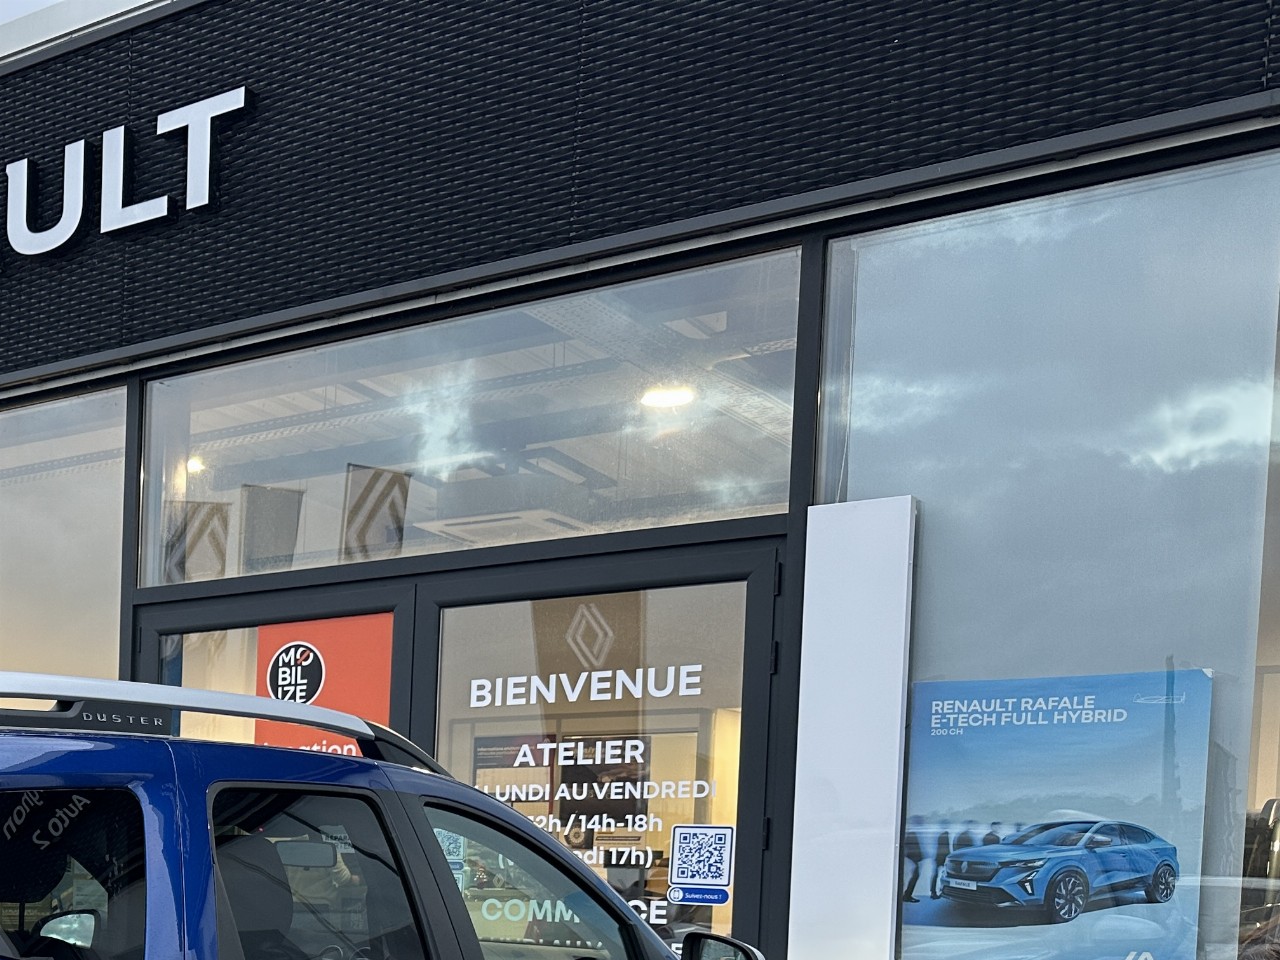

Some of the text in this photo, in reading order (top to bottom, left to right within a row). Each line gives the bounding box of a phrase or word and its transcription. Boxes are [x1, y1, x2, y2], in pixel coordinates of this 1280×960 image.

[278, 666, 307, 685] BIL
[470, 664, 703, 708] BIENVENUE
[931, 695, 1096, 714] RENAULT RAFALE
[82, 712, 163, 726] DUSTER
[930, 708, 1128, 728] E-TECH FULL HYBRID
[930, 727, 964, 736] 200 CH
[513, 739, 645, 768] ATELIER
[553, 782, 588, 801] AU
[591, 780, 718, 801] VENDREDI
[579, 813, 663, 833] 14h-18h
[609, 846, 654, 869] 17h)
